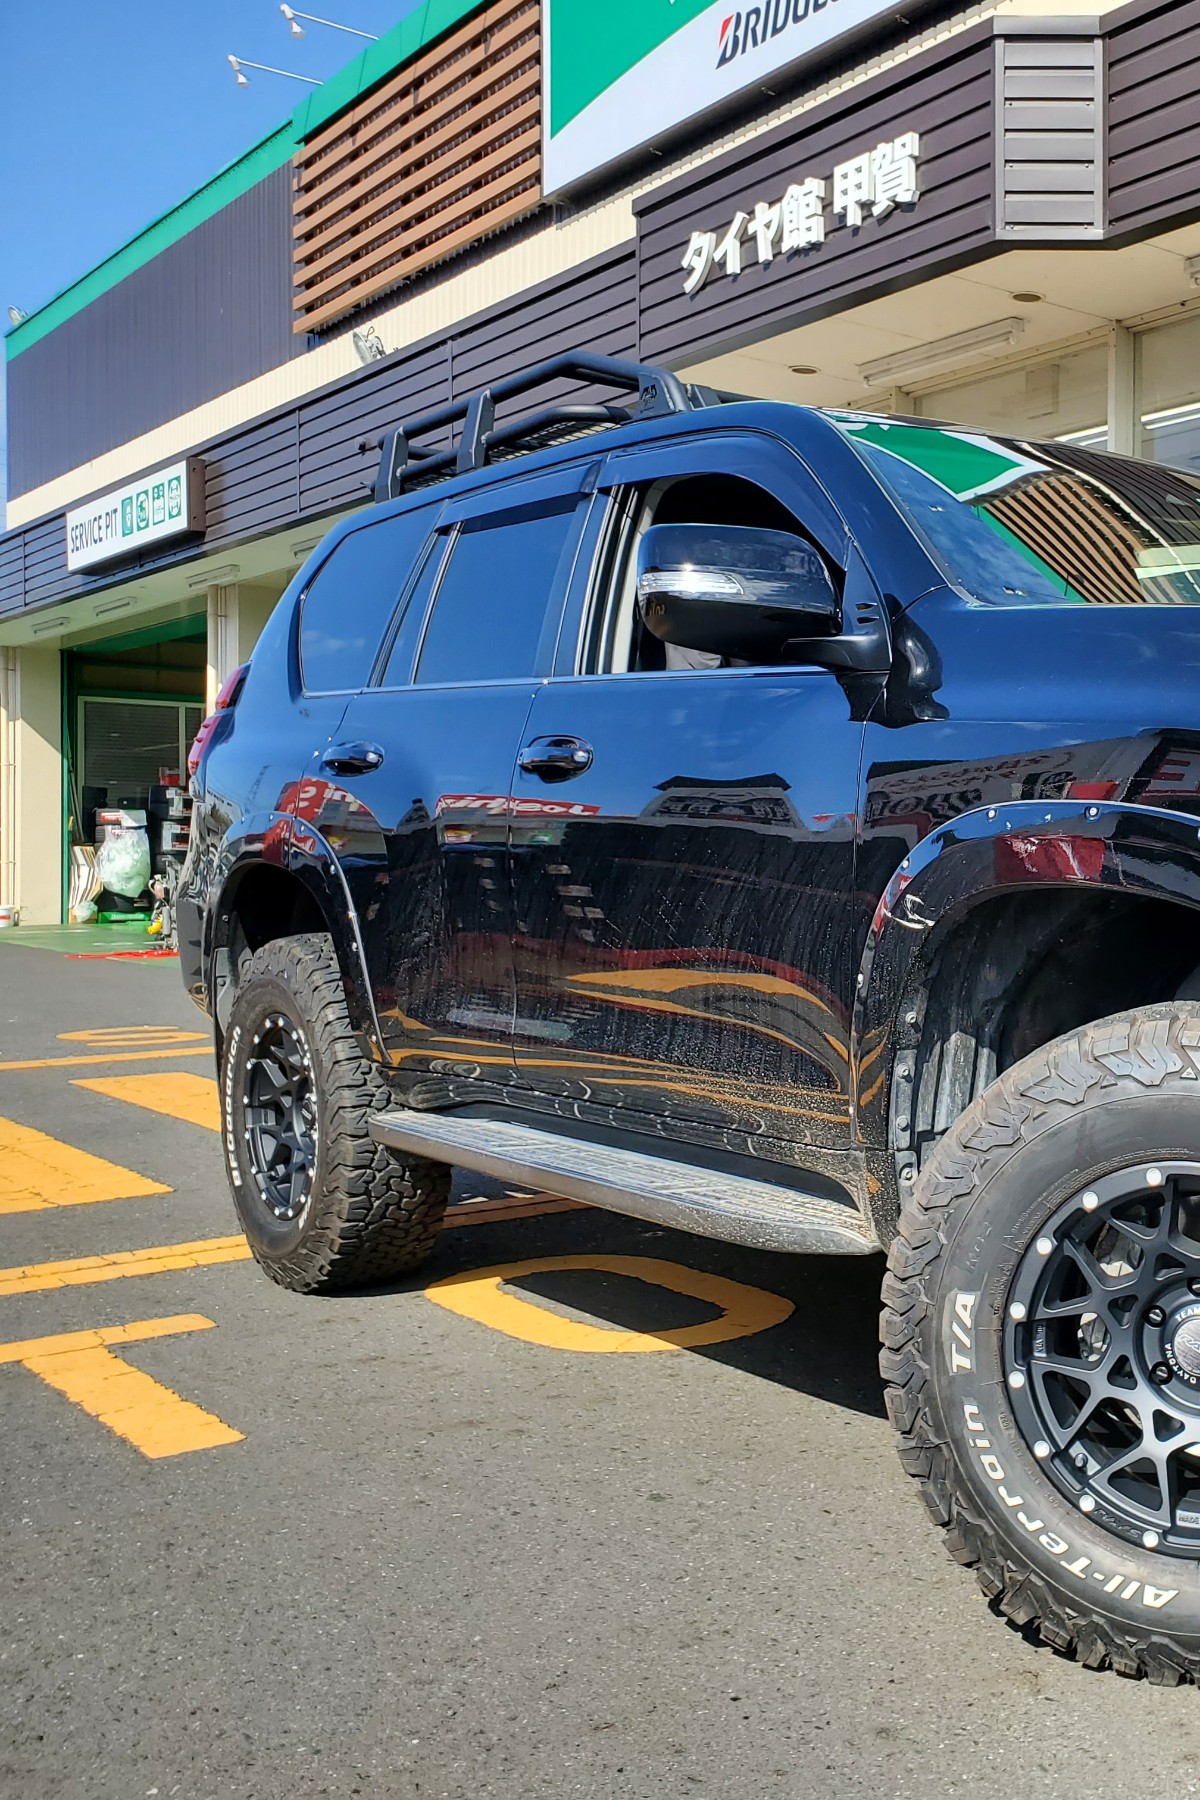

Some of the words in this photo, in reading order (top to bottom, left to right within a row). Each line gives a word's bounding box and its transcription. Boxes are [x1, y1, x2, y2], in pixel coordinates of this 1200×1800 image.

[681, 177, 825, 293] タイヤ館
[833, 131, 920, 226] 甲賀
[70, 514, 103, 554] SERVICE
[105, 507, 118, 541] PIT
[951, 1293, 976, 1373] T/A
[1164, 1342, 1197, 1385] DAYTONA
[963, 1404, 1180, 1608] All-Terrain
